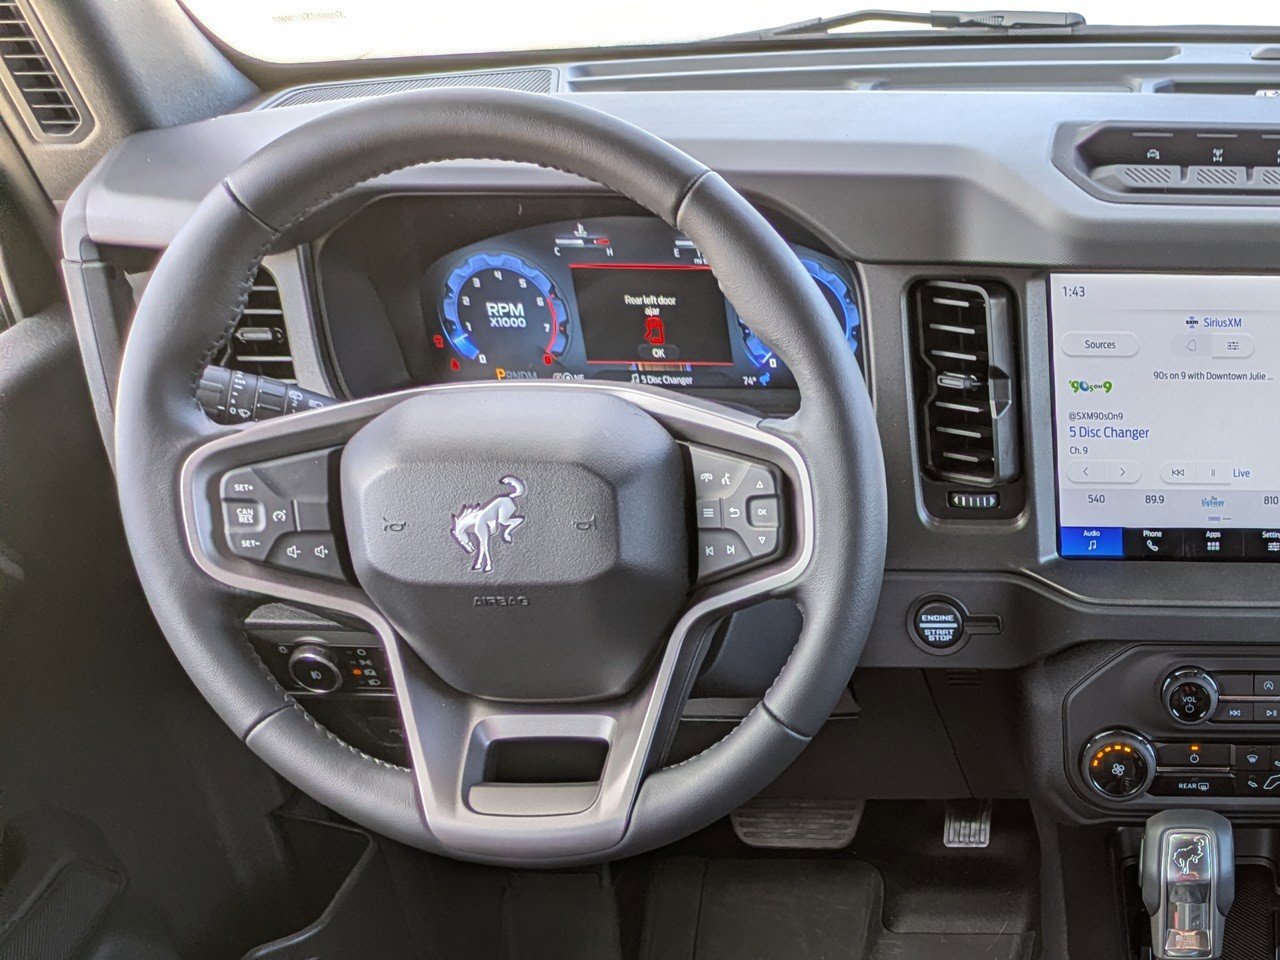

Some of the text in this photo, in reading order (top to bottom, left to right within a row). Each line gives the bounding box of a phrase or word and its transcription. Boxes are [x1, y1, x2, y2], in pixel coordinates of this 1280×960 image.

[554, 247, 561, 256] C
[606, 248, 614, 257] H
[673, 248, 680, 258] E
[494, 270, 502, 281] 4
[472, 278, 481, 288] 3
[518, 279, 527, 288] 5
[1062, 286, 1086, 298] 1:43
[462, 296, 471, 306] 2
[536, 296, 544, 307] 6
[624, 295, 676, 306] Rear left door
[486, 302, 525, 317] RPM
[644, 307, 660, 317] ajar
[490, 317, 527, 329] X1000
[1203, 317, 1242, 328] SiriusXM
[543, 323, 550, 333] 7
[1085, 339, 1116, 350] Sources
[652, 348, 665, 358] OK
[647, 375, 662, 385] Disc
[662, 376, 693, 387] Changer
[1153, 371, 1168, 381] 90s
[1169, 373, 1180, 381] on
[1181, 371, 1186, 381] 9
[1187, 371, 1205, 381] with
[1206, 371, 1247, 381] Downtown
[1249, 371, 1266, 381] Julie
[1103, 380, 1113, 394] 9
[1068, 411, 1124, 421] @SXM90sOn9
[1069, 426, 1149, 441] 5 Disc Changer
[1069, 446, 1088, 455] Ch. 9
[1233, 468, 1251, 478] Live
[234, 484, 254, 492] SET+
[1088, 494, 1105, 504] 540
[1145, 495, 1165, 504] 89.9
[1264, 496, 1279, 505] 810
[238, 515, 254, 524] RES
[1083, 529, 1100, 537] Audio
[1142, 530, 1162, 538] Phone
[1205, 530, 1221, 539] Apps
[921, 614, 955, 622] ENGINE
